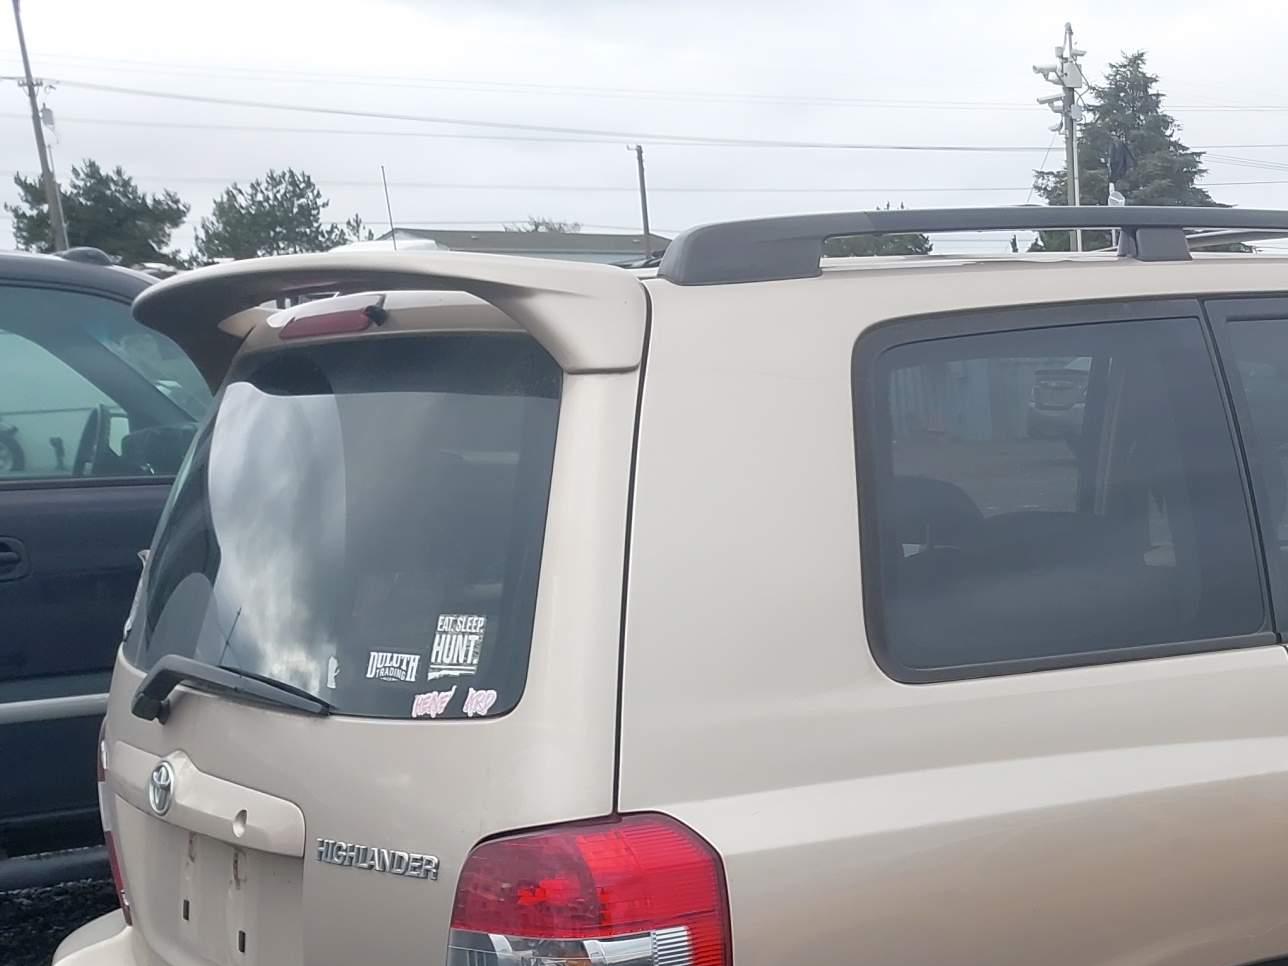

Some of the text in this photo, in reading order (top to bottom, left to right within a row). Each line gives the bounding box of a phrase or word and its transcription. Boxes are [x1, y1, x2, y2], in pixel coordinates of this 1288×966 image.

[366, 652, 420, 681] DULUTH
[375, 667, 406, 681] TRADING
[316, 838, 440, 880] HIGHLANDER
